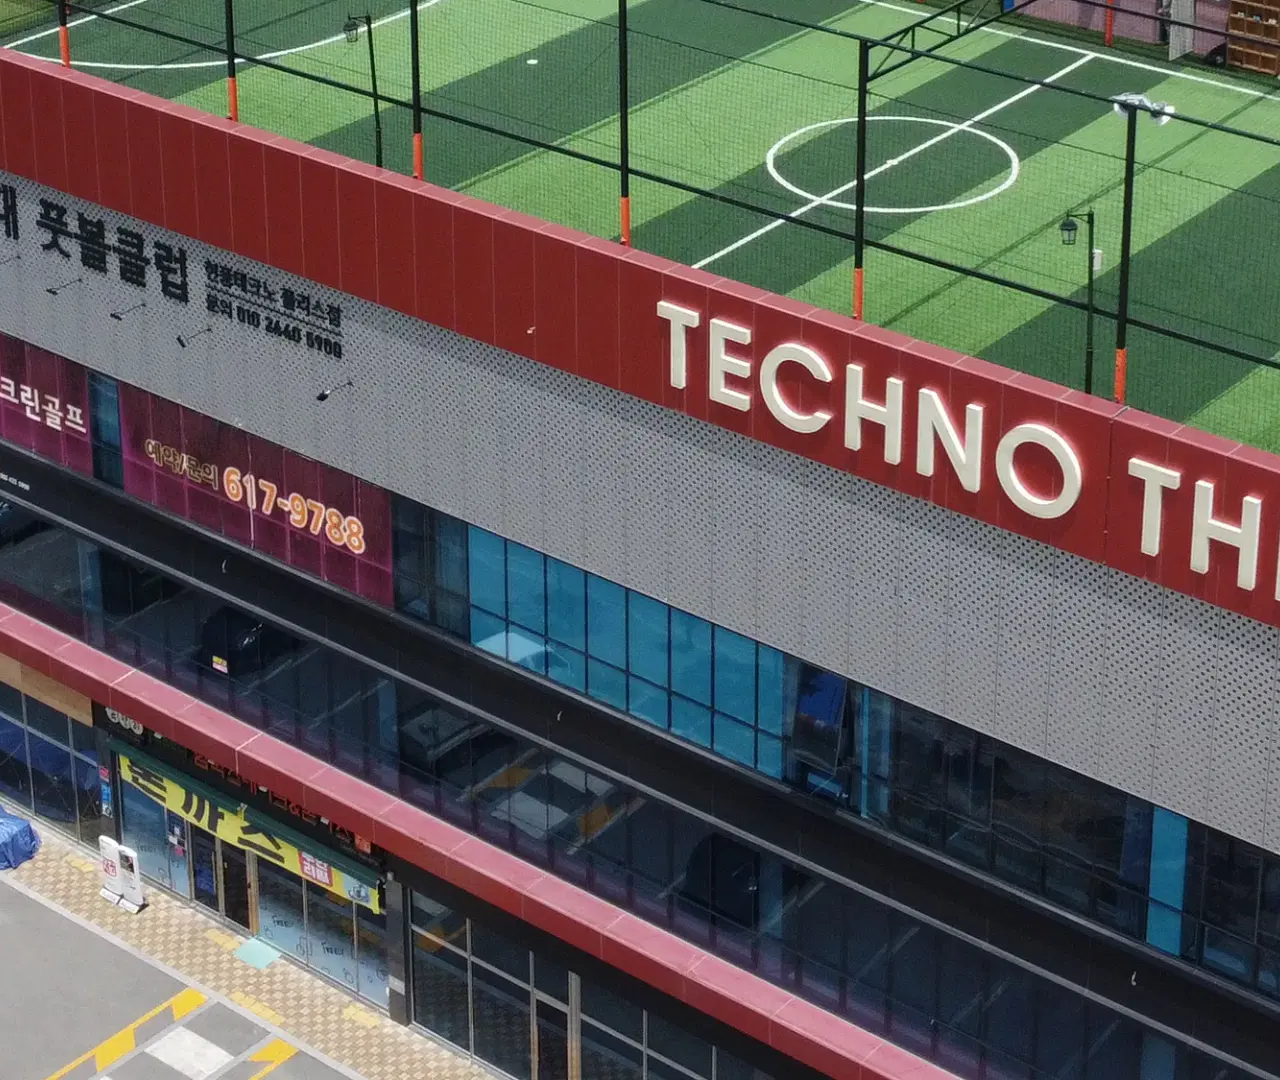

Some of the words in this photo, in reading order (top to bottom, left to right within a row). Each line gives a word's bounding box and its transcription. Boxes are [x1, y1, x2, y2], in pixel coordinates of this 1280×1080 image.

[36, 197, 190, 305] 풋볼클럽
[206, 293, 233, 322] 문의
[236, 305, 261, 329] 010
[656, 300, 1083, 520] TECHNO
[145, 439, 218, 490] 예약/문의
[223, 467, 365, 554] 617-9788
